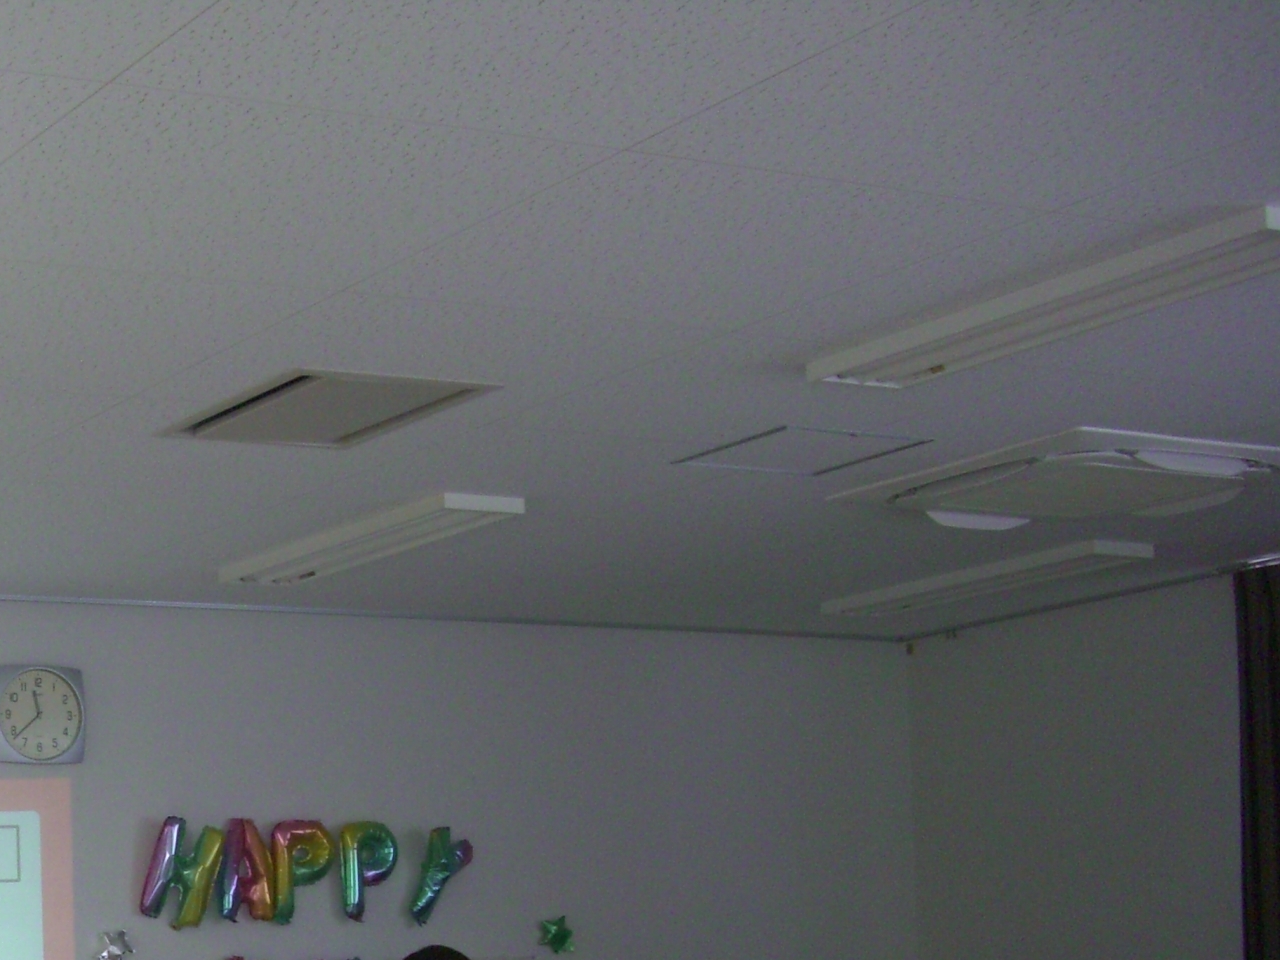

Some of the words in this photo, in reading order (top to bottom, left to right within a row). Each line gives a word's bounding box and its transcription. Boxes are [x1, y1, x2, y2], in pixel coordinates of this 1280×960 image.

[20, 682, 27, 692] 11
[34, 677, 43, 688] 12
[52, 682, 56, 692] 1
[9, 692, 19, 703] 10
[62, 694, 68, 705] 2
[5, 709, 12, 720] 9
[66, 710, 73, 721] 3
[10, 725, 17, 736] 8
[62, 727, 69, 737] 4
[21, 737, 28, 747] 7
[36, 742, 43, 753] 6
[52, 737, 59, 748] 5
[140, 815, 474, 930] HAPPY
